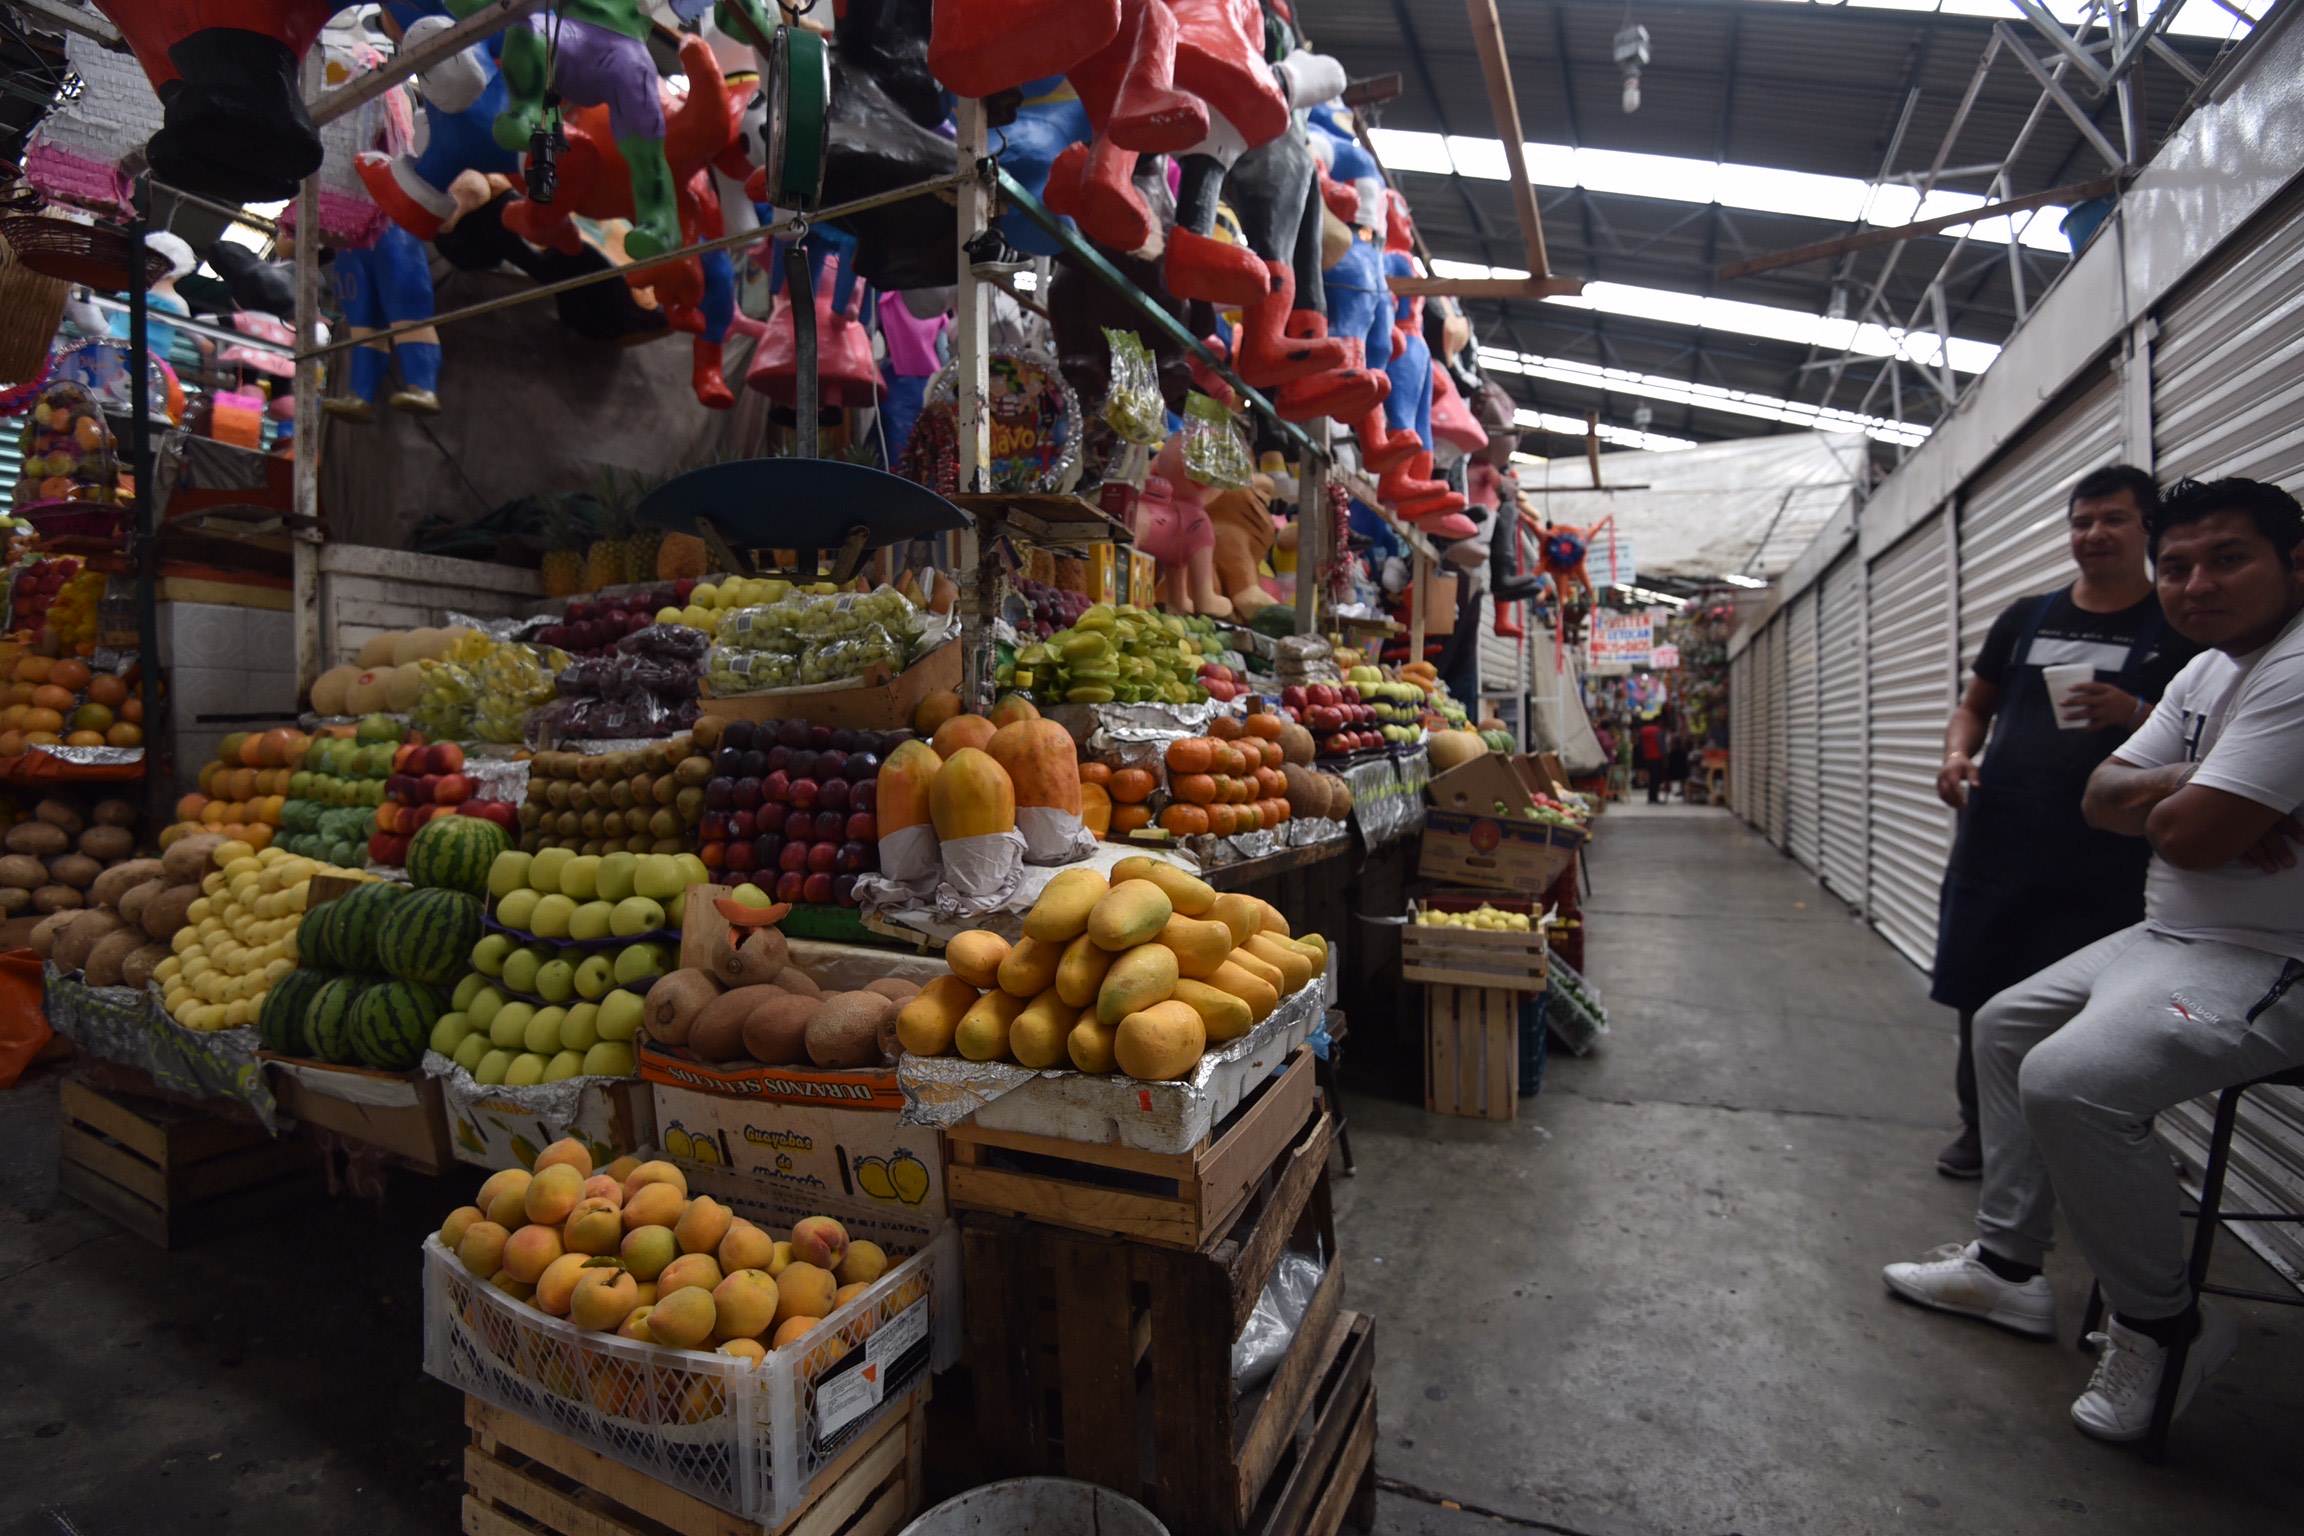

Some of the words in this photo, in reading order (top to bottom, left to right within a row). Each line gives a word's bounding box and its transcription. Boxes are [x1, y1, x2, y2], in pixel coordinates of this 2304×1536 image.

[2171, 992, 2220, 1024] Reebok
[668, 1065, 761, 1092] SELECTOS
[766, 1077, 873, 1101] DURAZNOS
[744, 1124, 813, 1151] Guayabas
[775, 1153, 793, 1169] de
